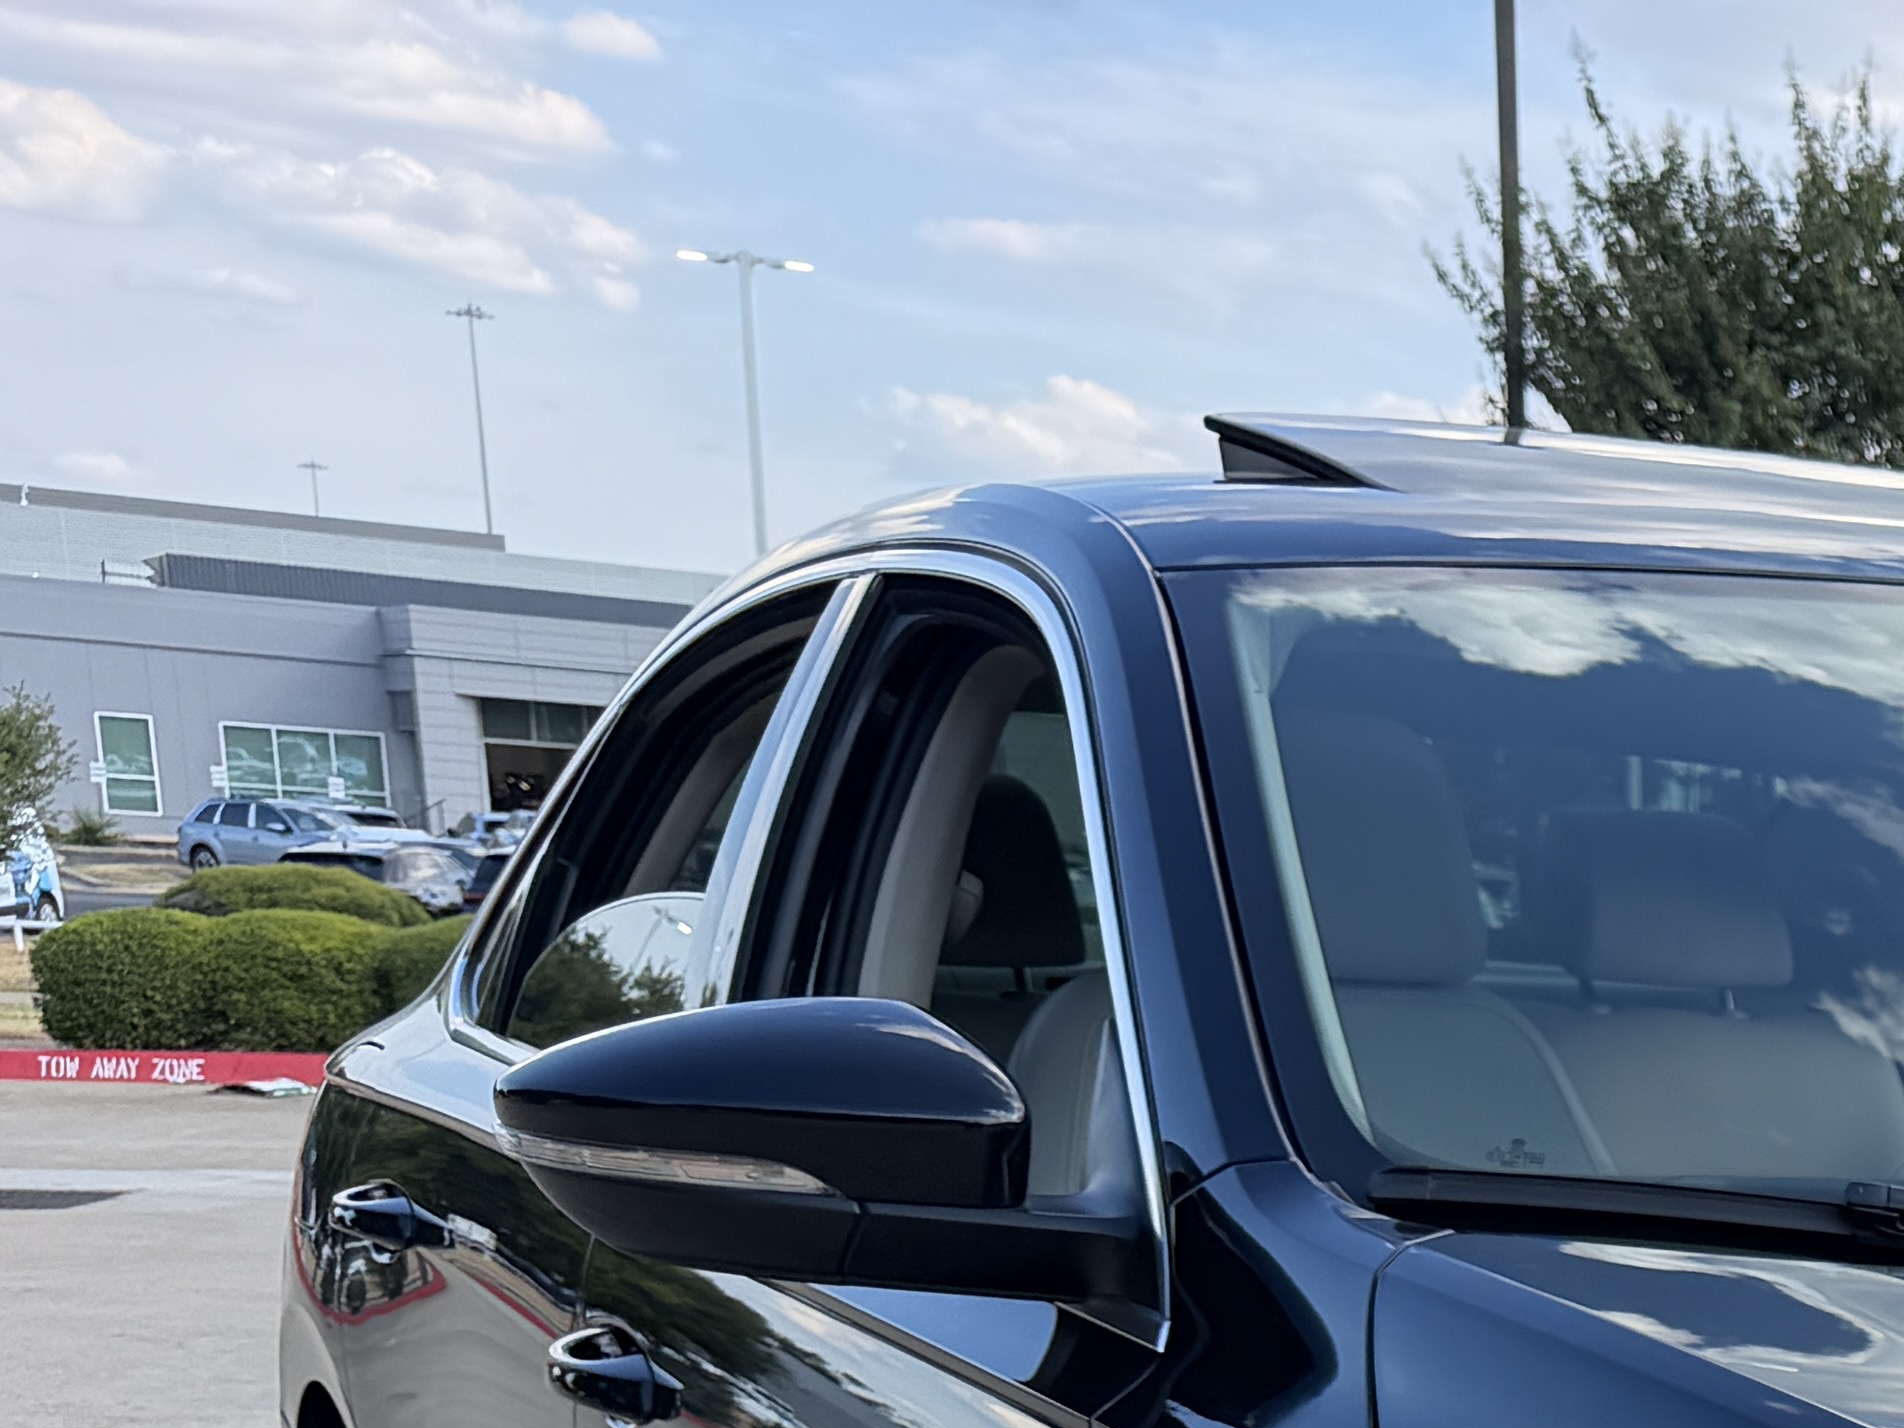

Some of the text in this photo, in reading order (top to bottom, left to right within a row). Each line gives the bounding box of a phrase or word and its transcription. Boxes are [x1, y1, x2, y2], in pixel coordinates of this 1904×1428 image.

[38, 1055, 206, 1082] TOW AWAY ZONE
